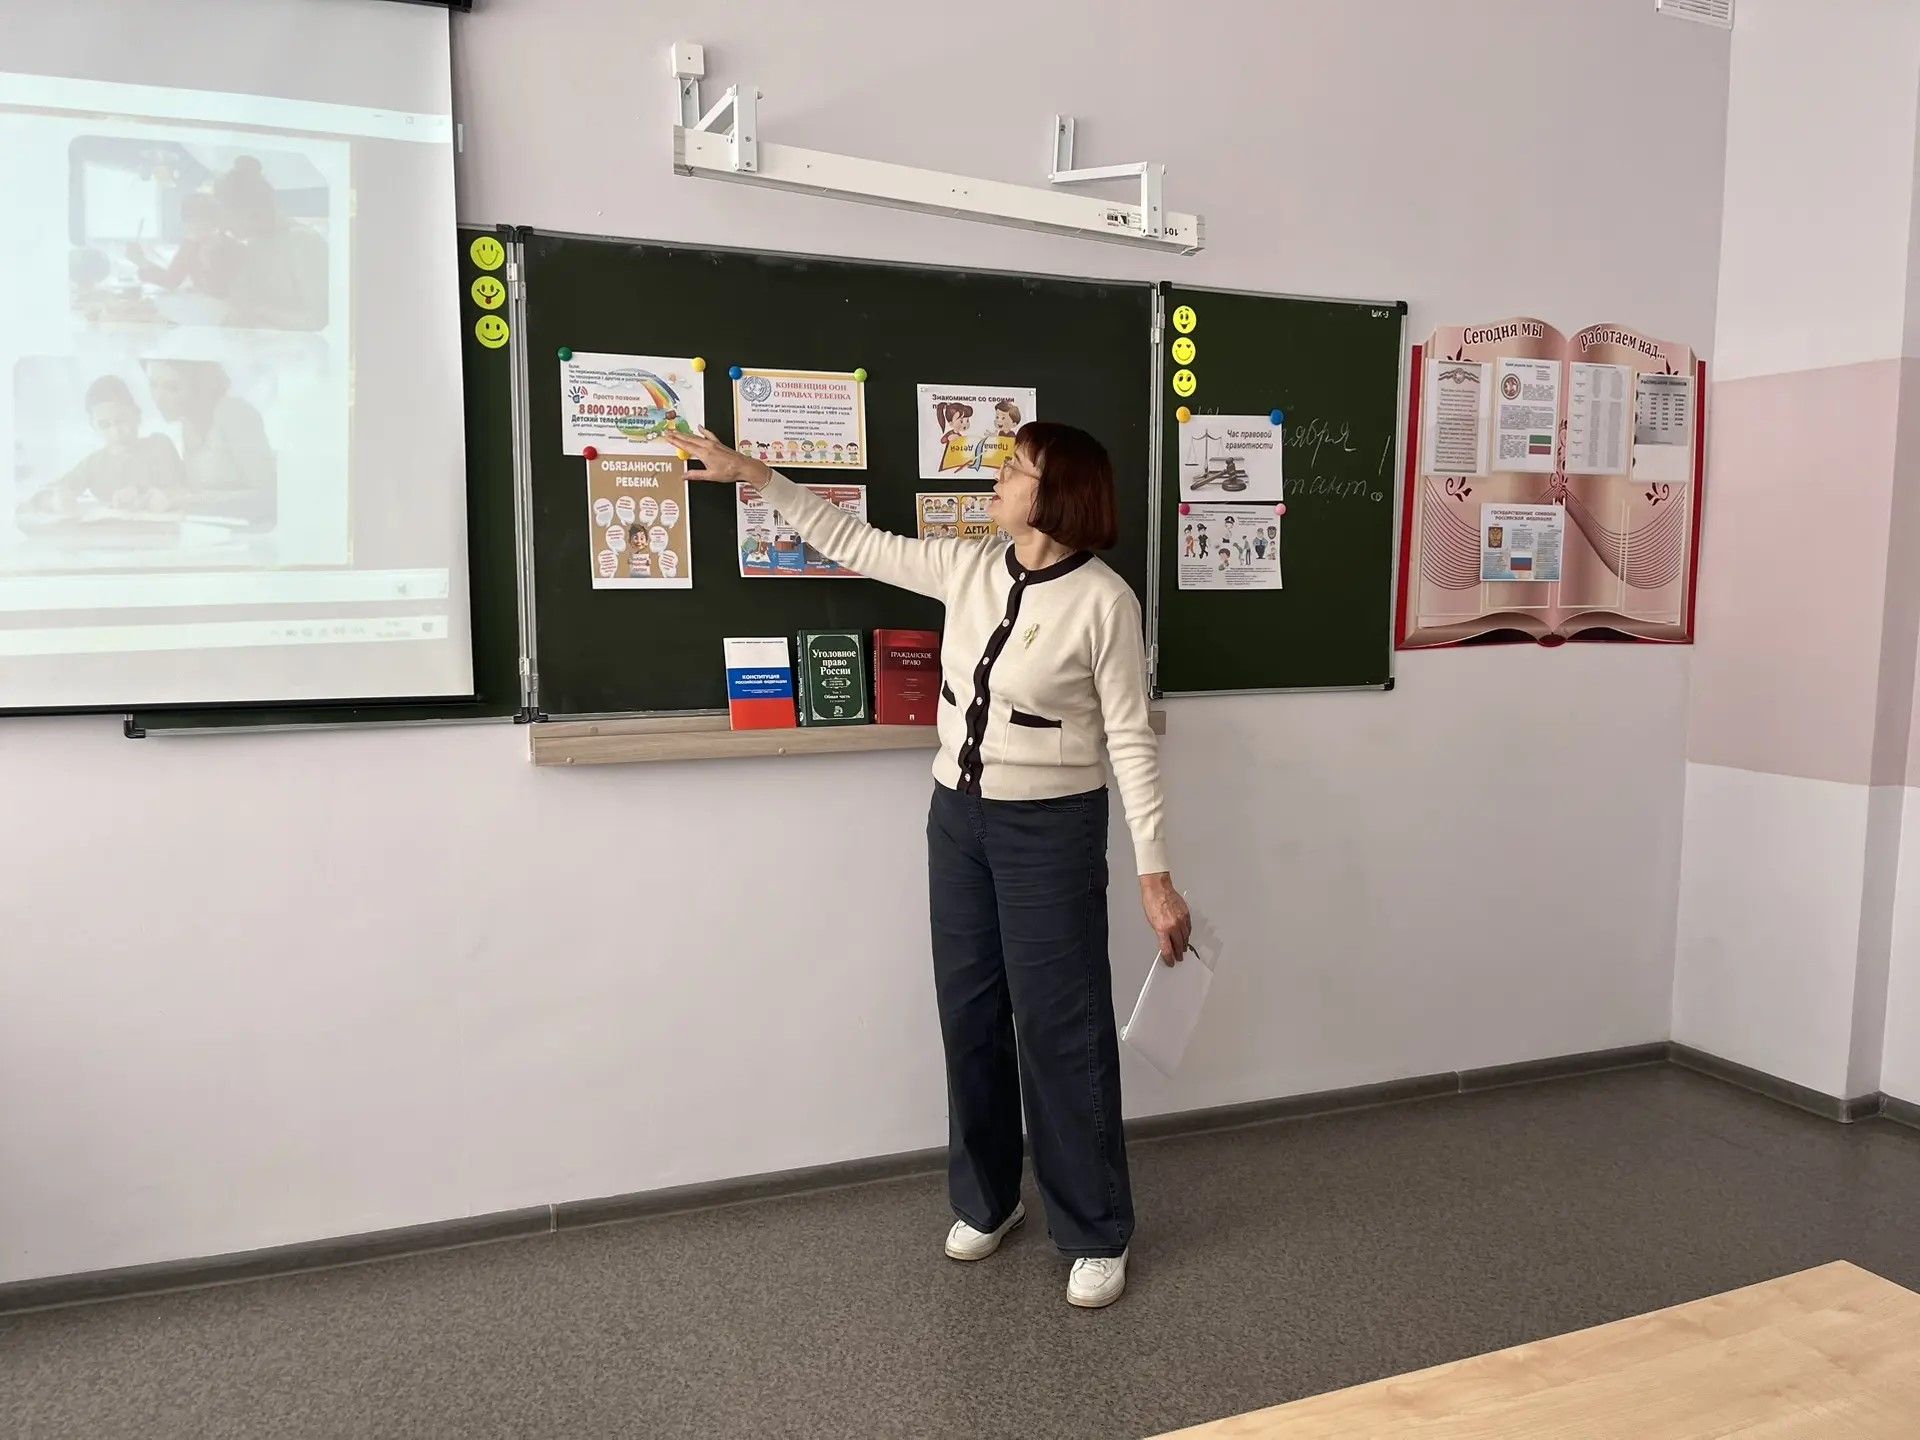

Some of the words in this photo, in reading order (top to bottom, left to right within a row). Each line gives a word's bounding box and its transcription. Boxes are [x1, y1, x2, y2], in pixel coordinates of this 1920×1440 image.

[1463, 323, 1518, 345] Сегодня
[1521, 321, 1545, 338] мы
[1579, 326, 1638, 352] работаем
[775, 381, 828, 391] КОНВЕНЦИЯ
[592, 393, 614, 401] Просто
[781, 392, 813, 400] ПРАВАХ
[932, 394, 977, 402] Знакомимся
[578, 404, 586, 414] 8
[586, 404, 605, 415] 800
[606, 405, 630, 416] 2000
[632, 406, 649, 417] 122
[571, 414, 598, 422] Детский
[599, 416, 626, 424] телефон
[1226, 429, 1240, 438] Час
[1240, 430, 1272, 440] правовой
[984, 443, 1008, 451] Права
[1225, 442, 1274, 450] грамотности
[601, 460, 672, 472] ОБЯЗАННОСТИ
[616, 476, 660, 488] РЕБЕНКА
[964, 526, 990, 534] ДЕТИ
[812, 649, 857, 658] Уголовное
[822, 659, 847, 668] право
[820, 666, 851, 675] России
